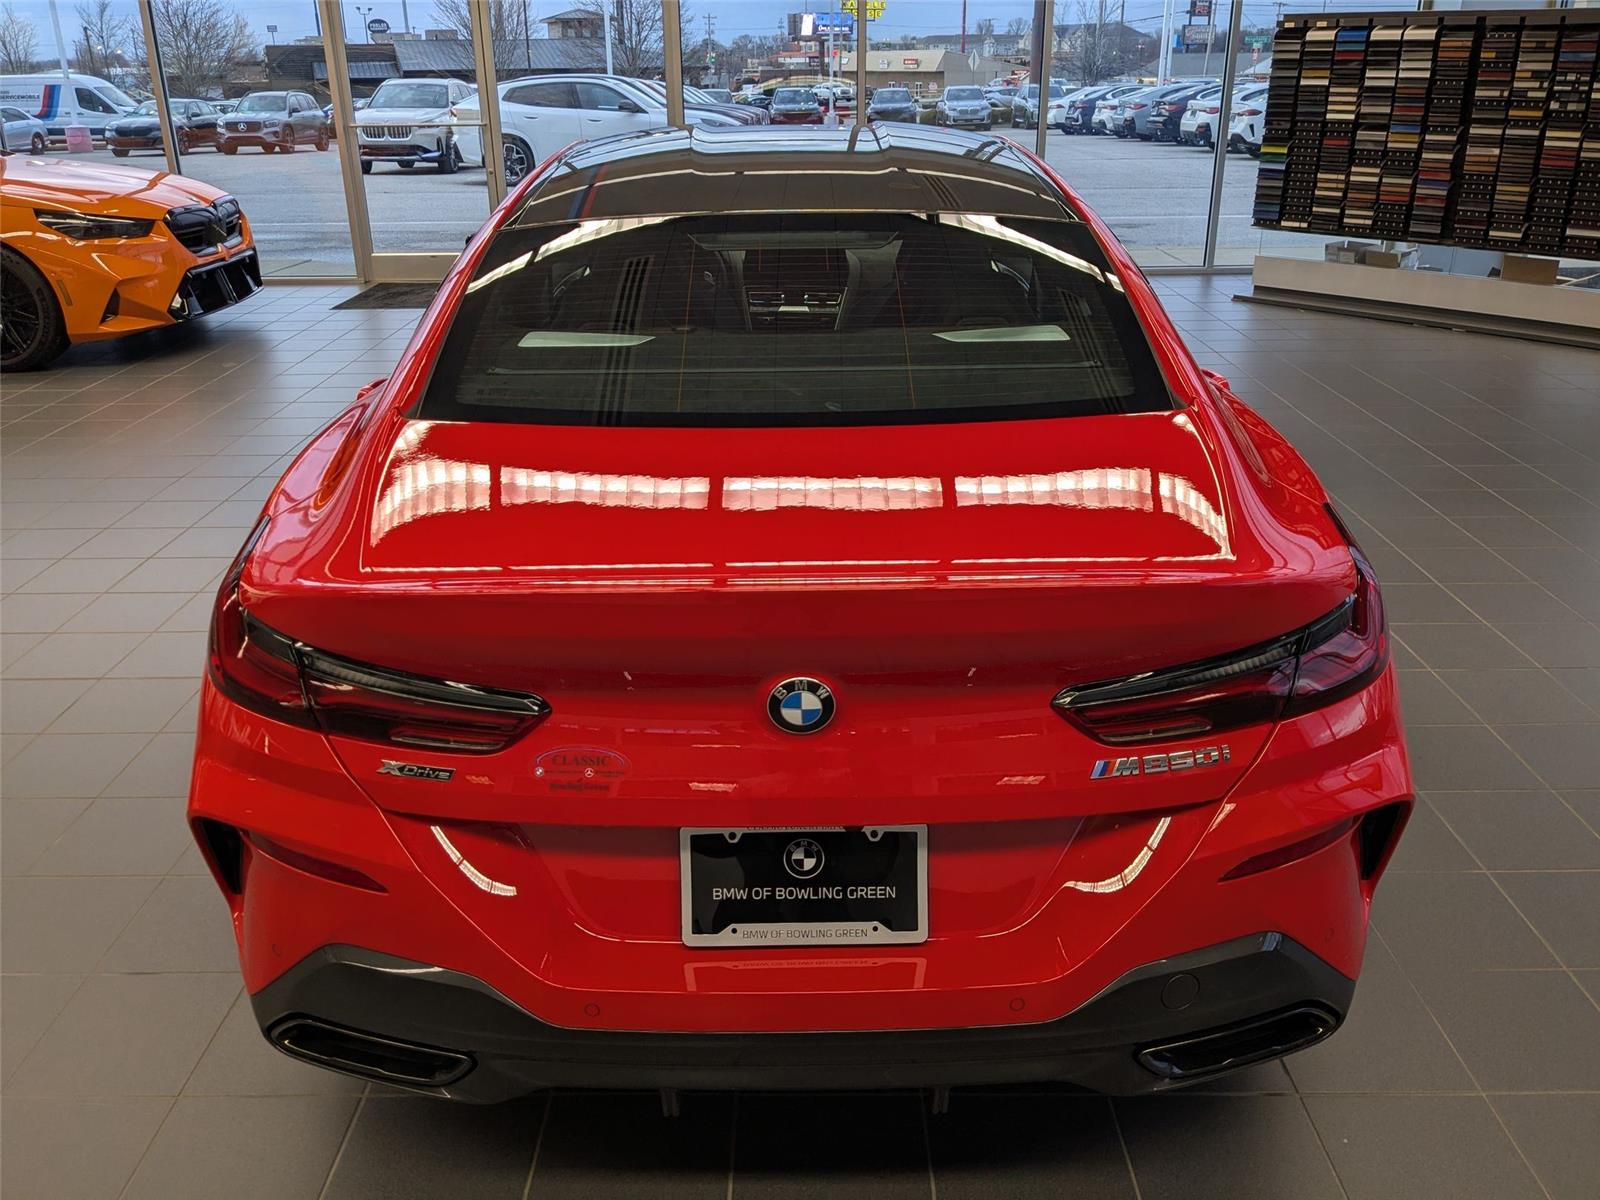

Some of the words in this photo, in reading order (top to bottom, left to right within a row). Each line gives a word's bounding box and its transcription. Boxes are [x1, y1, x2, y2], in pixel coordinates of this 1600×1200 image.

[773, 680, 830, 700] BMW
[552, 755, 608, 767] CLASSIC
[789, 840, 819, 852] BMW
[712, 887, 748, 900] BMW
[751, 887, 772, 900] OF
[775, 886, 843, 900] BOWLING
[846, 885, 897, 899] GREEN
[742, 929, 768, 939] BMW
[770, 929, 785, 939] OF
[786, 928, 833, 939] BOWLING
[835, 928, 868, 938] GREEN
